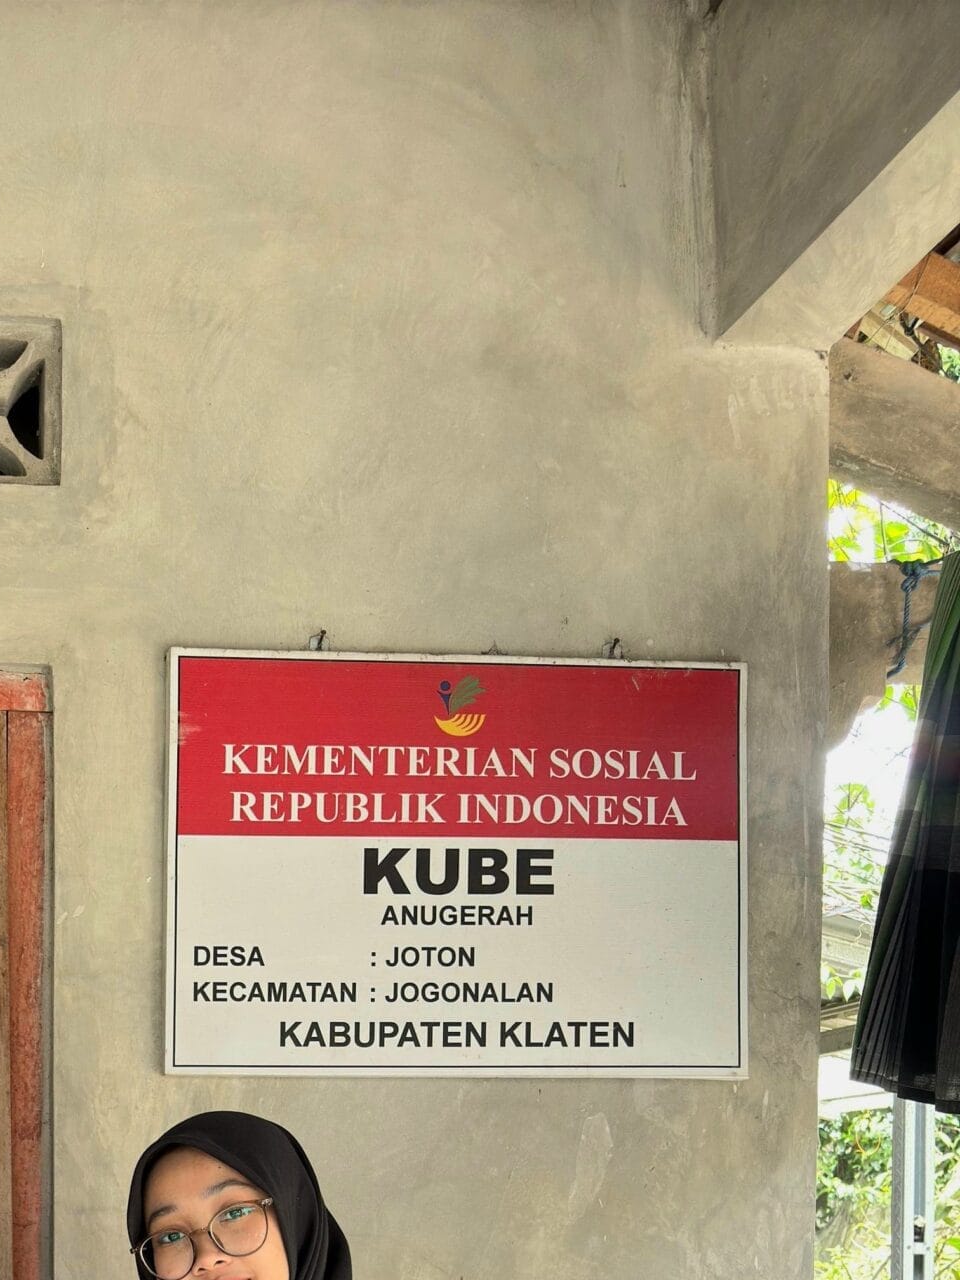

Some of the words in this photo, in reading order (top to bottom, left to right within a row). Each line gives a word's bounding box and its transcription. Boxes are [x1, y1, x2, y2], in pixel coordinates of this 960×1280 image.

[221, 743, 538, 778] KEMENTERIAN
[549, 747, 698, 781] SOSIAL
[229, 791, 446, 824] REPUBLIK
[456, 793, 688, 826] INDONESIA
[363, 848, 555, 895] KUBE
[381, 905, 533, 926] ANUGERAH
[193, 946, 265, 967] DESA
[385, 947, 475, 967] JOTON
[193, 982, 357, 1003] KECAMATAN
[385, 982, 554, 1003] JOGONALAN
[279, 1021, 487, 1048] KABUPATEN
[499, 1022, 635, 1049] KLATEN
